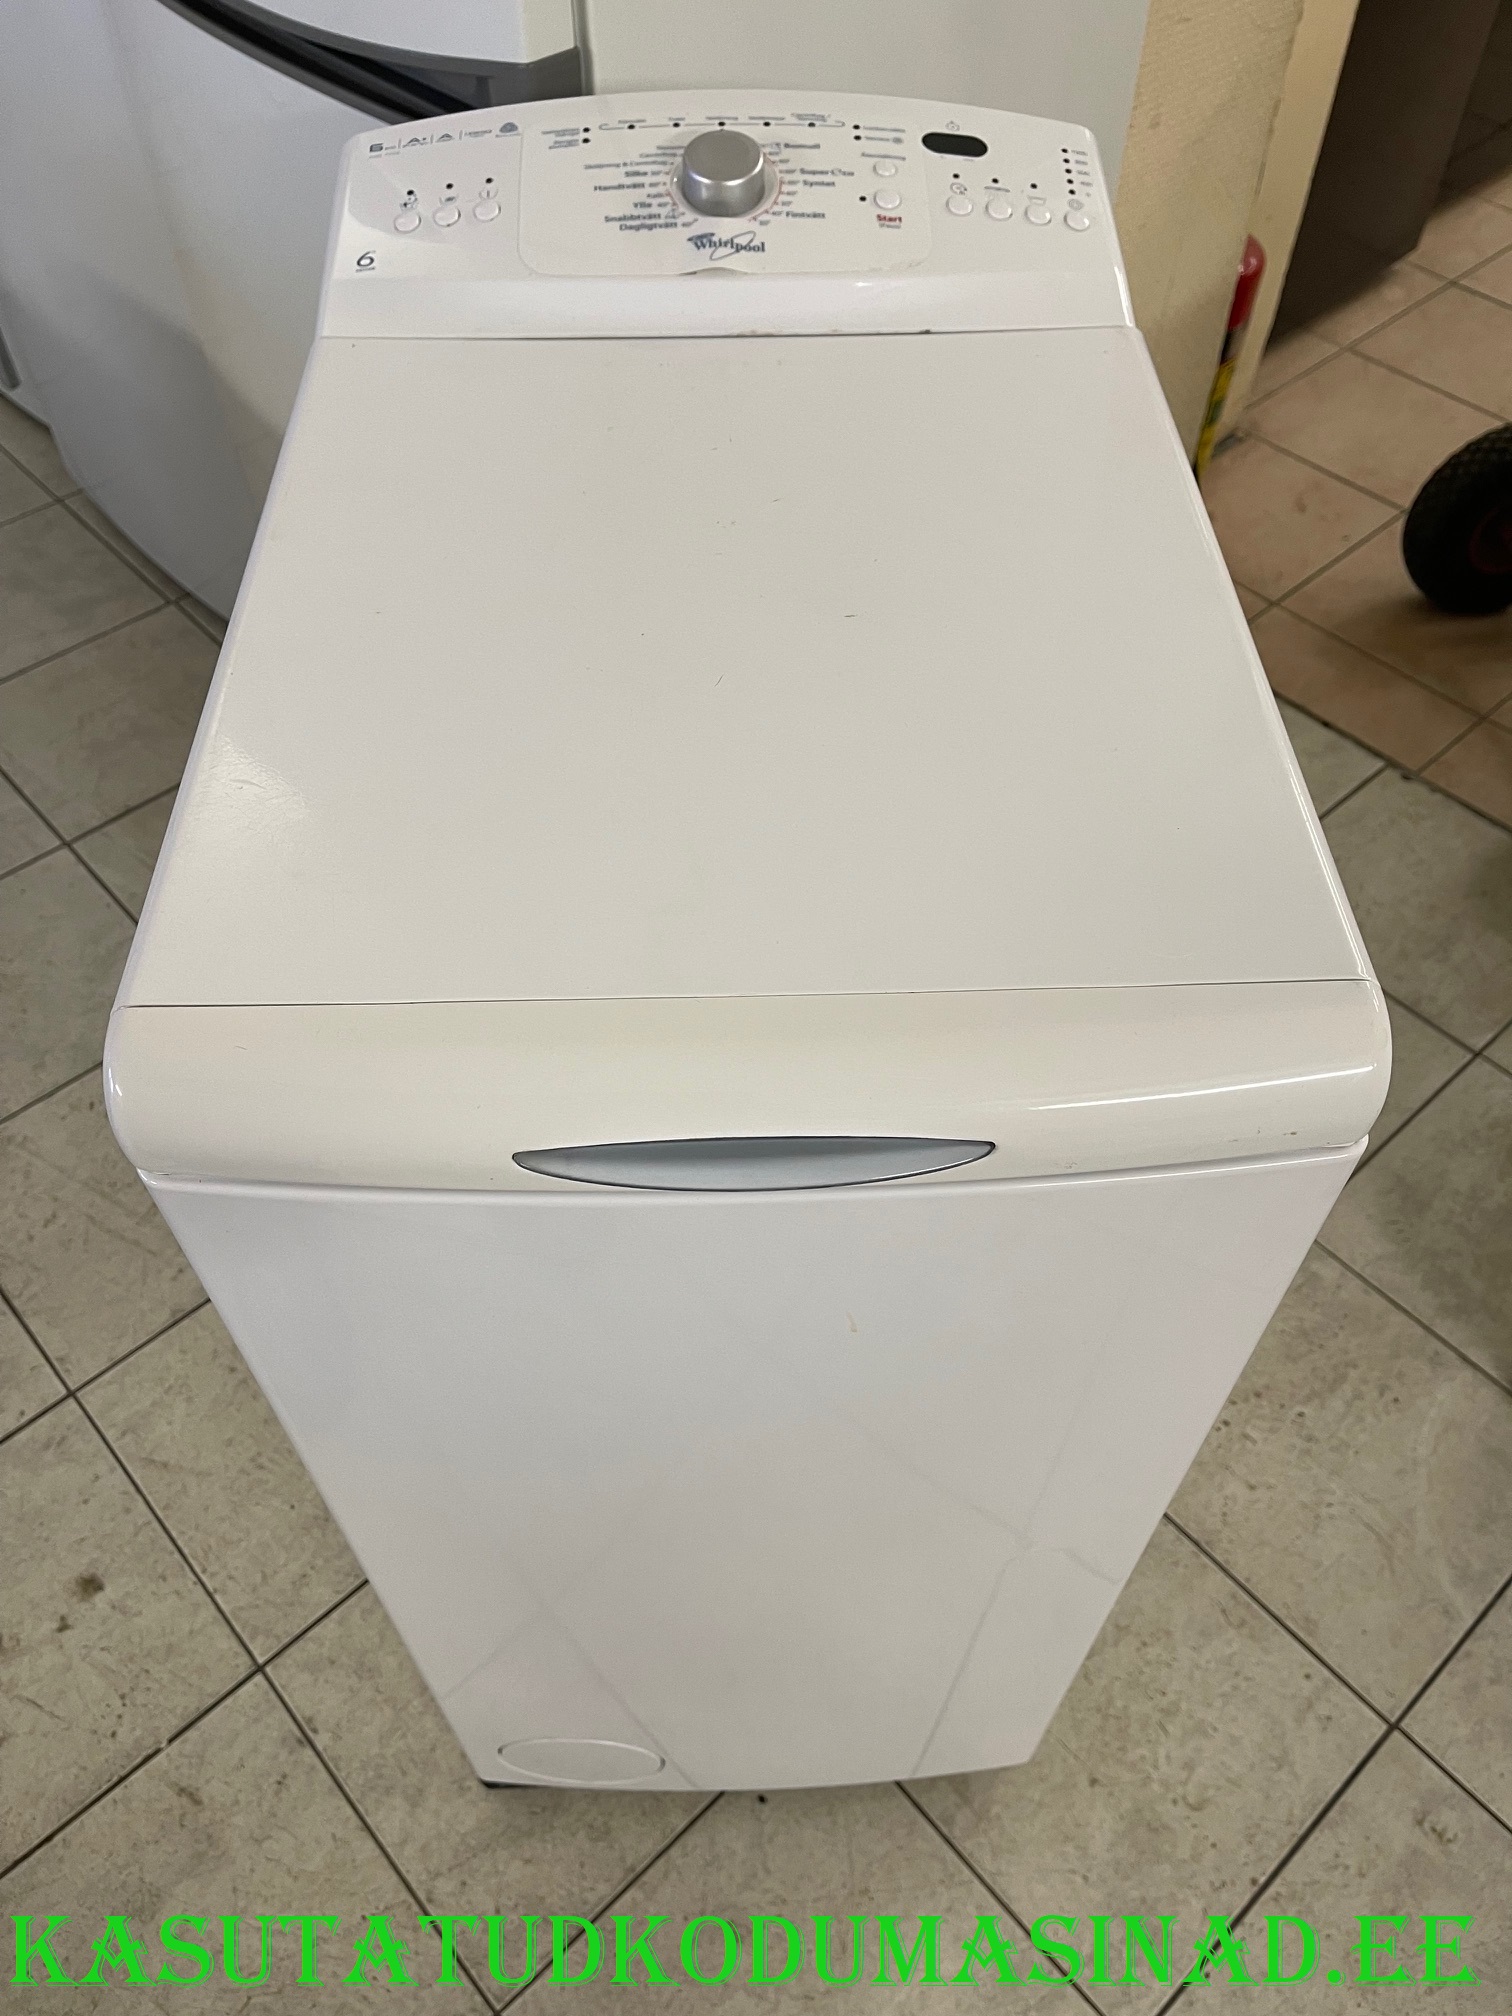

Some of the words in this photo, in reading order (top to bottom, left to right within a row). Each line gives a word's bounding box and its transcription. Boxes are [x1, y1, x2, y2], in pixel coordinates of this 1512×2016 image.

[876, 214, 903, 223] Start
[688, 234, 766, 253] Whirlpool
[356, 251, 376, 267] 6
